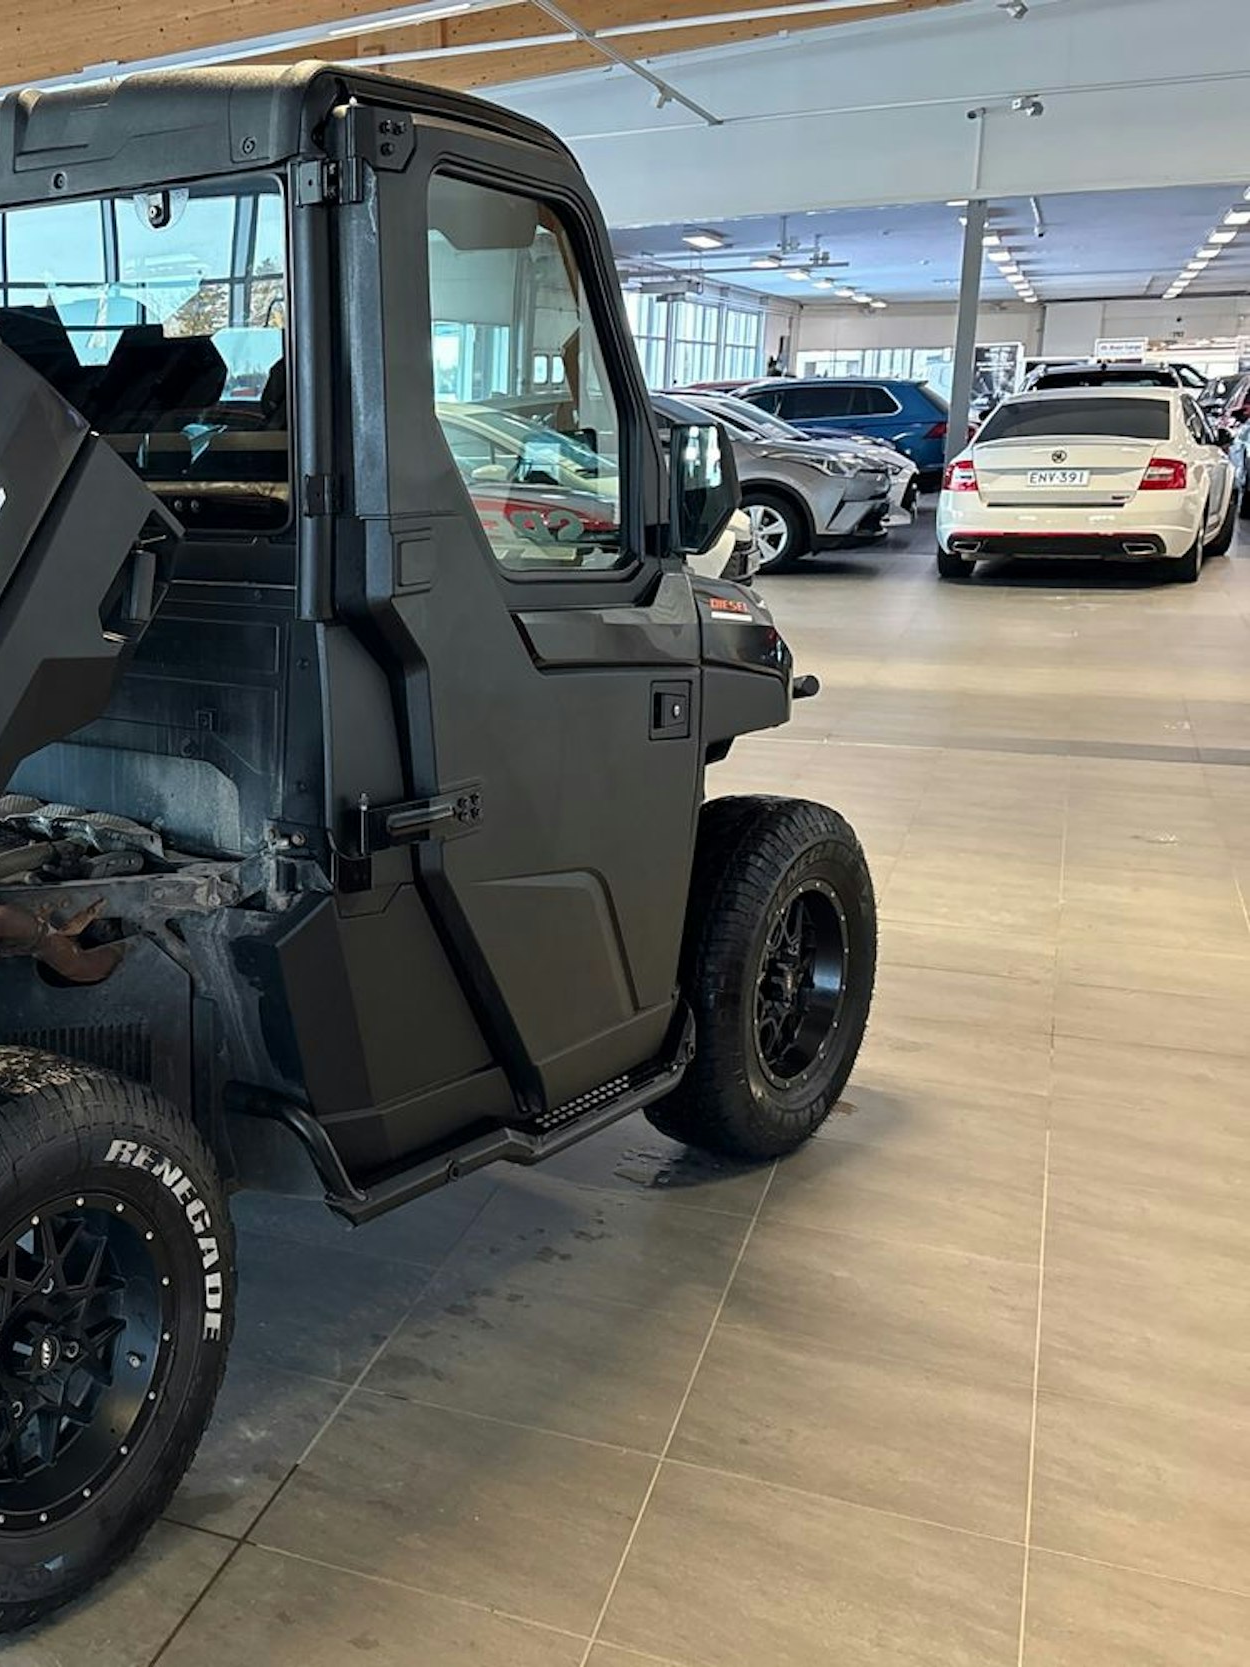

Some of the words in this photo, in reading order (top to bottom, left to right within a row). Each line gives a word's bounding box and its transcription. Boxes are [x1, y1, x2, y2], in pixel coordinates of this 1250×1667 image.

[1030, 472, 1085, 484] ENV-391
[709, 598, 749, 613] DIESEL
[103, 1138, 223, 1342] RENEGADE
